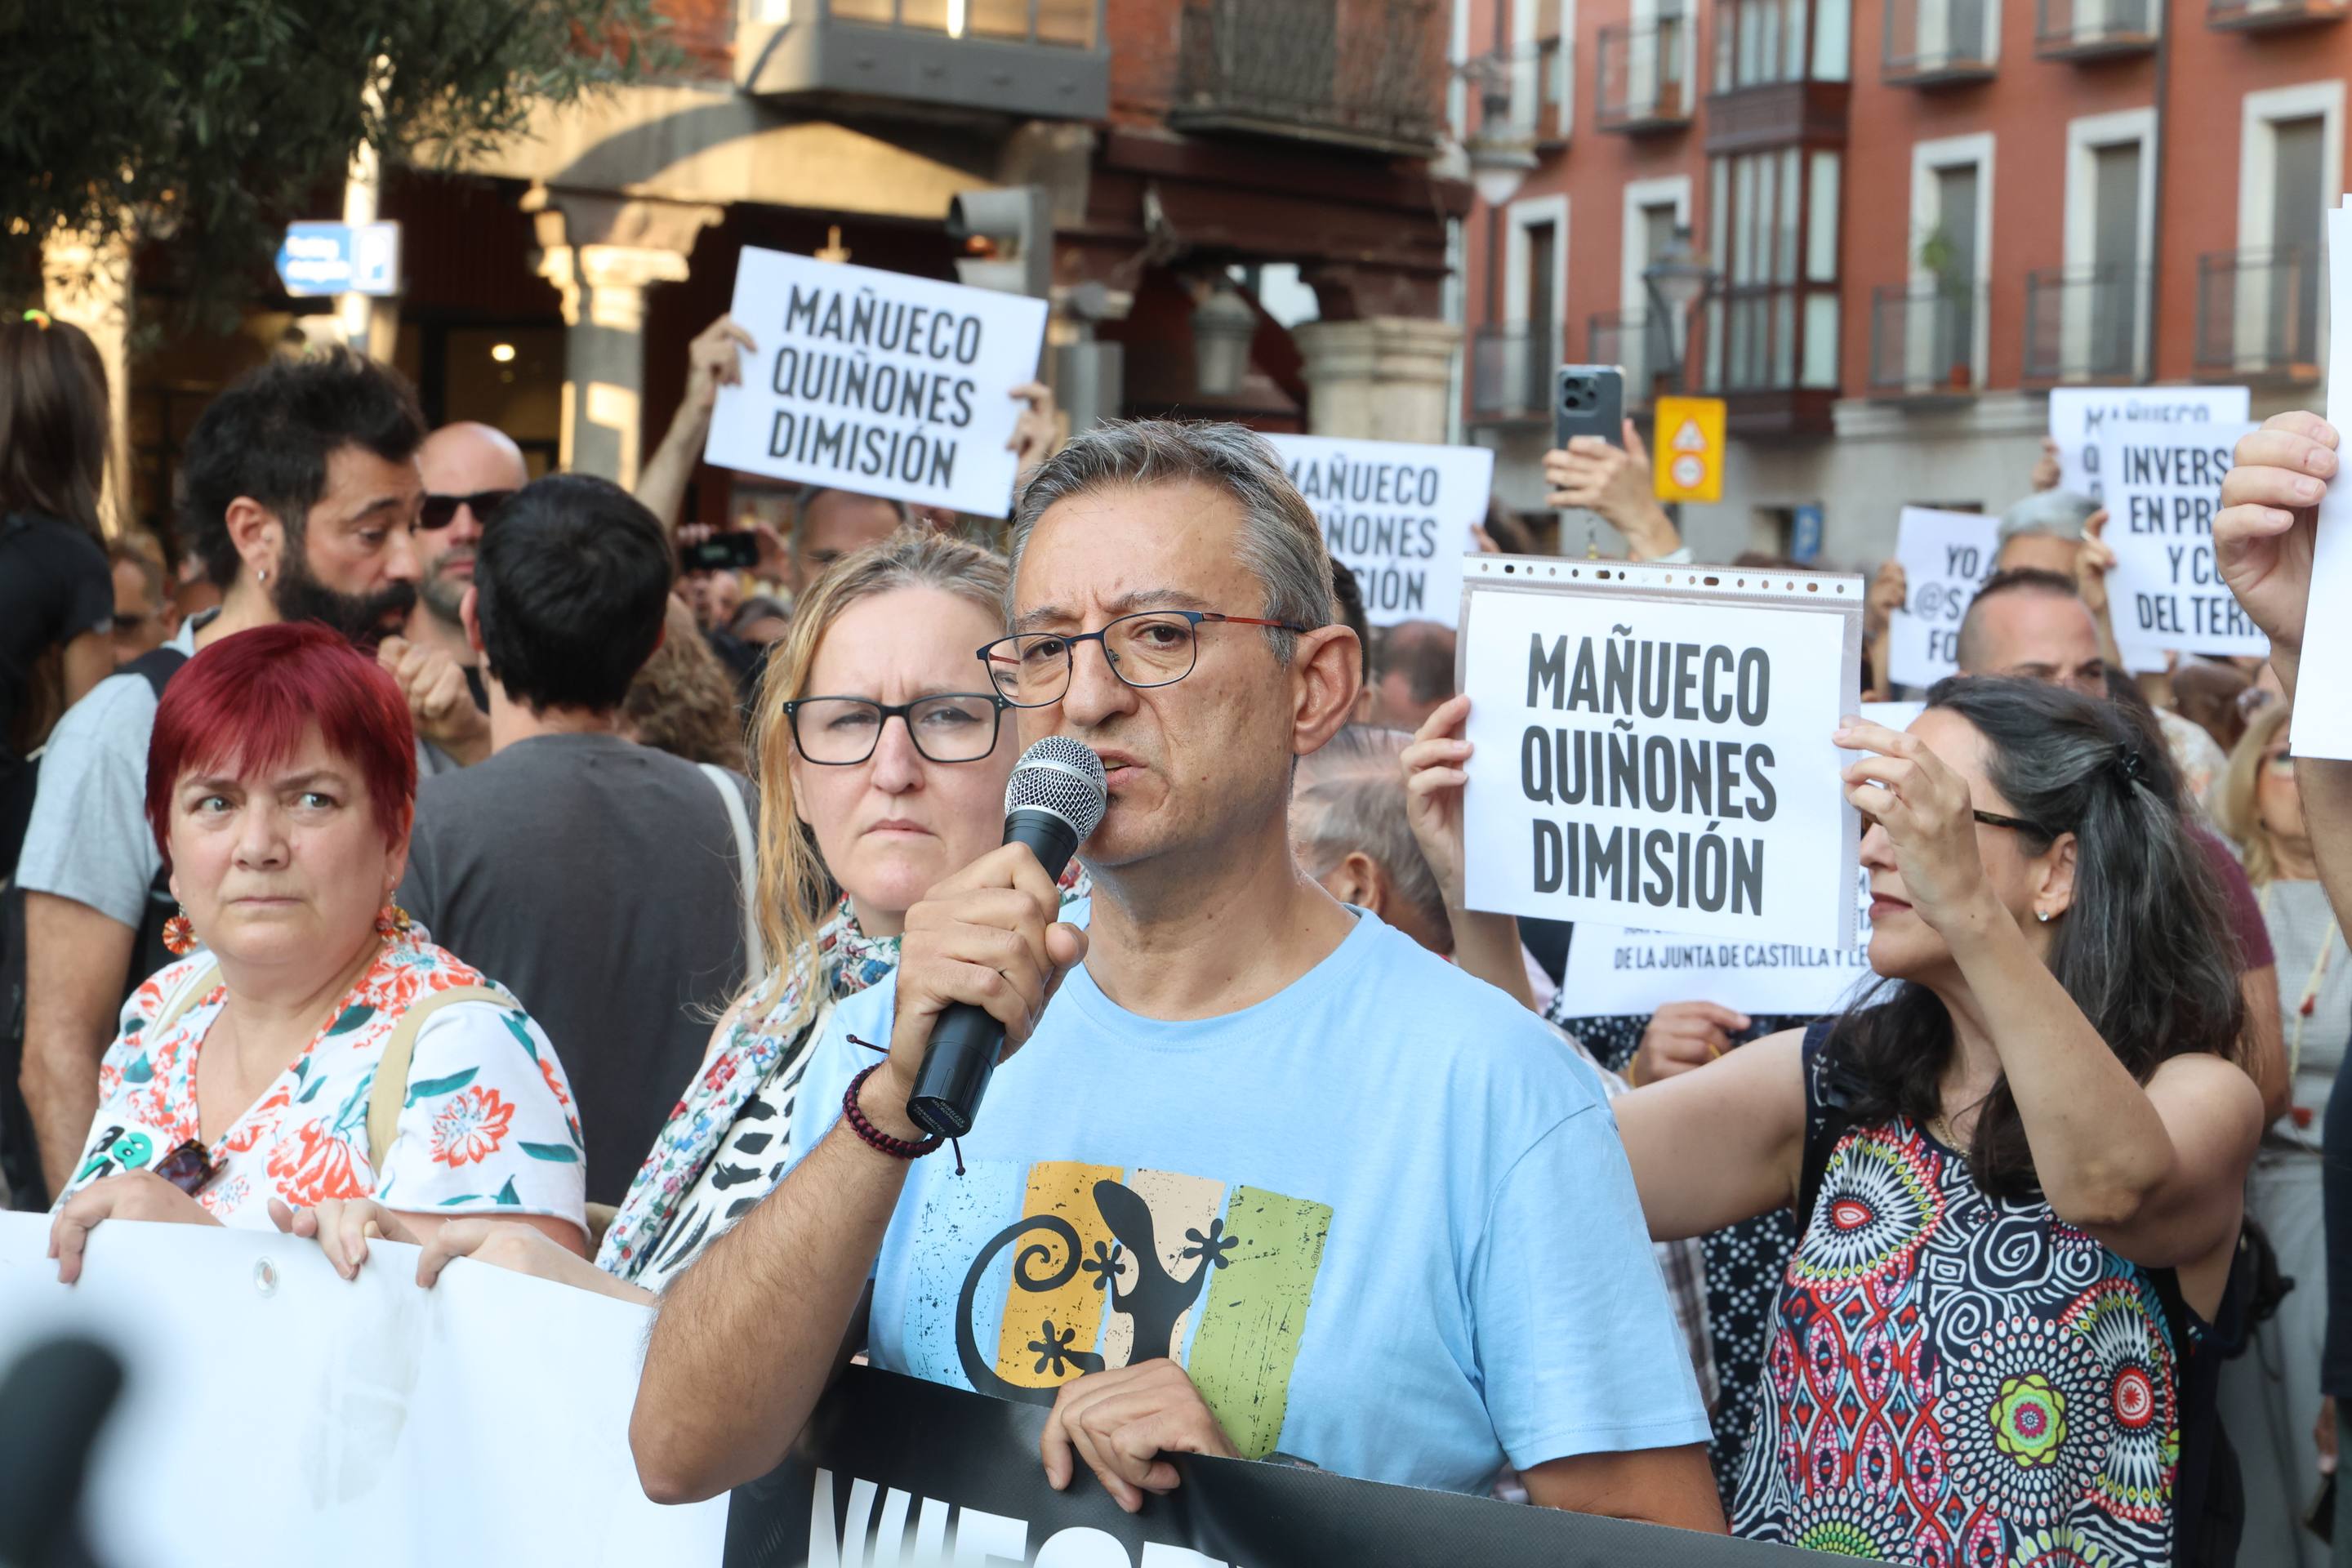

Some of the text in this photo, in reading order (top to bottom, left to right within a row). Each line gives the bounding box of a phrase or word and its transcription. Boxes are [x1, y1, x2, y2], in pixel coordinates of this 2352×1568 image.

[785, 283, 982, 364] MAÑUECO
[772, 347, 975, 427] QUIÑONES
[768, 410, 956, 488] DIMISIÓN
[2123, 446, 2234, 486] INVERS
[1318, 503, 1438, 559] ÑONES
[2129, 495, 2221, 535] EN PR
[1946, 545, 1977, 578] YO
[2167, 546, 2184, 584] Y
[2136, 593, 2265, 636] DEL TER
[1928, 629, 1958, 663] FO
[1526, 623, 1770, 727] MAÑUECO
[1521, 719, 1777, 822] QUIÑONES
[1533, 818, 1764, 916] DIMISIÓN
[1615, 944, 1867, 969] DE LA JUNTA DE CASTILLA Y LE
